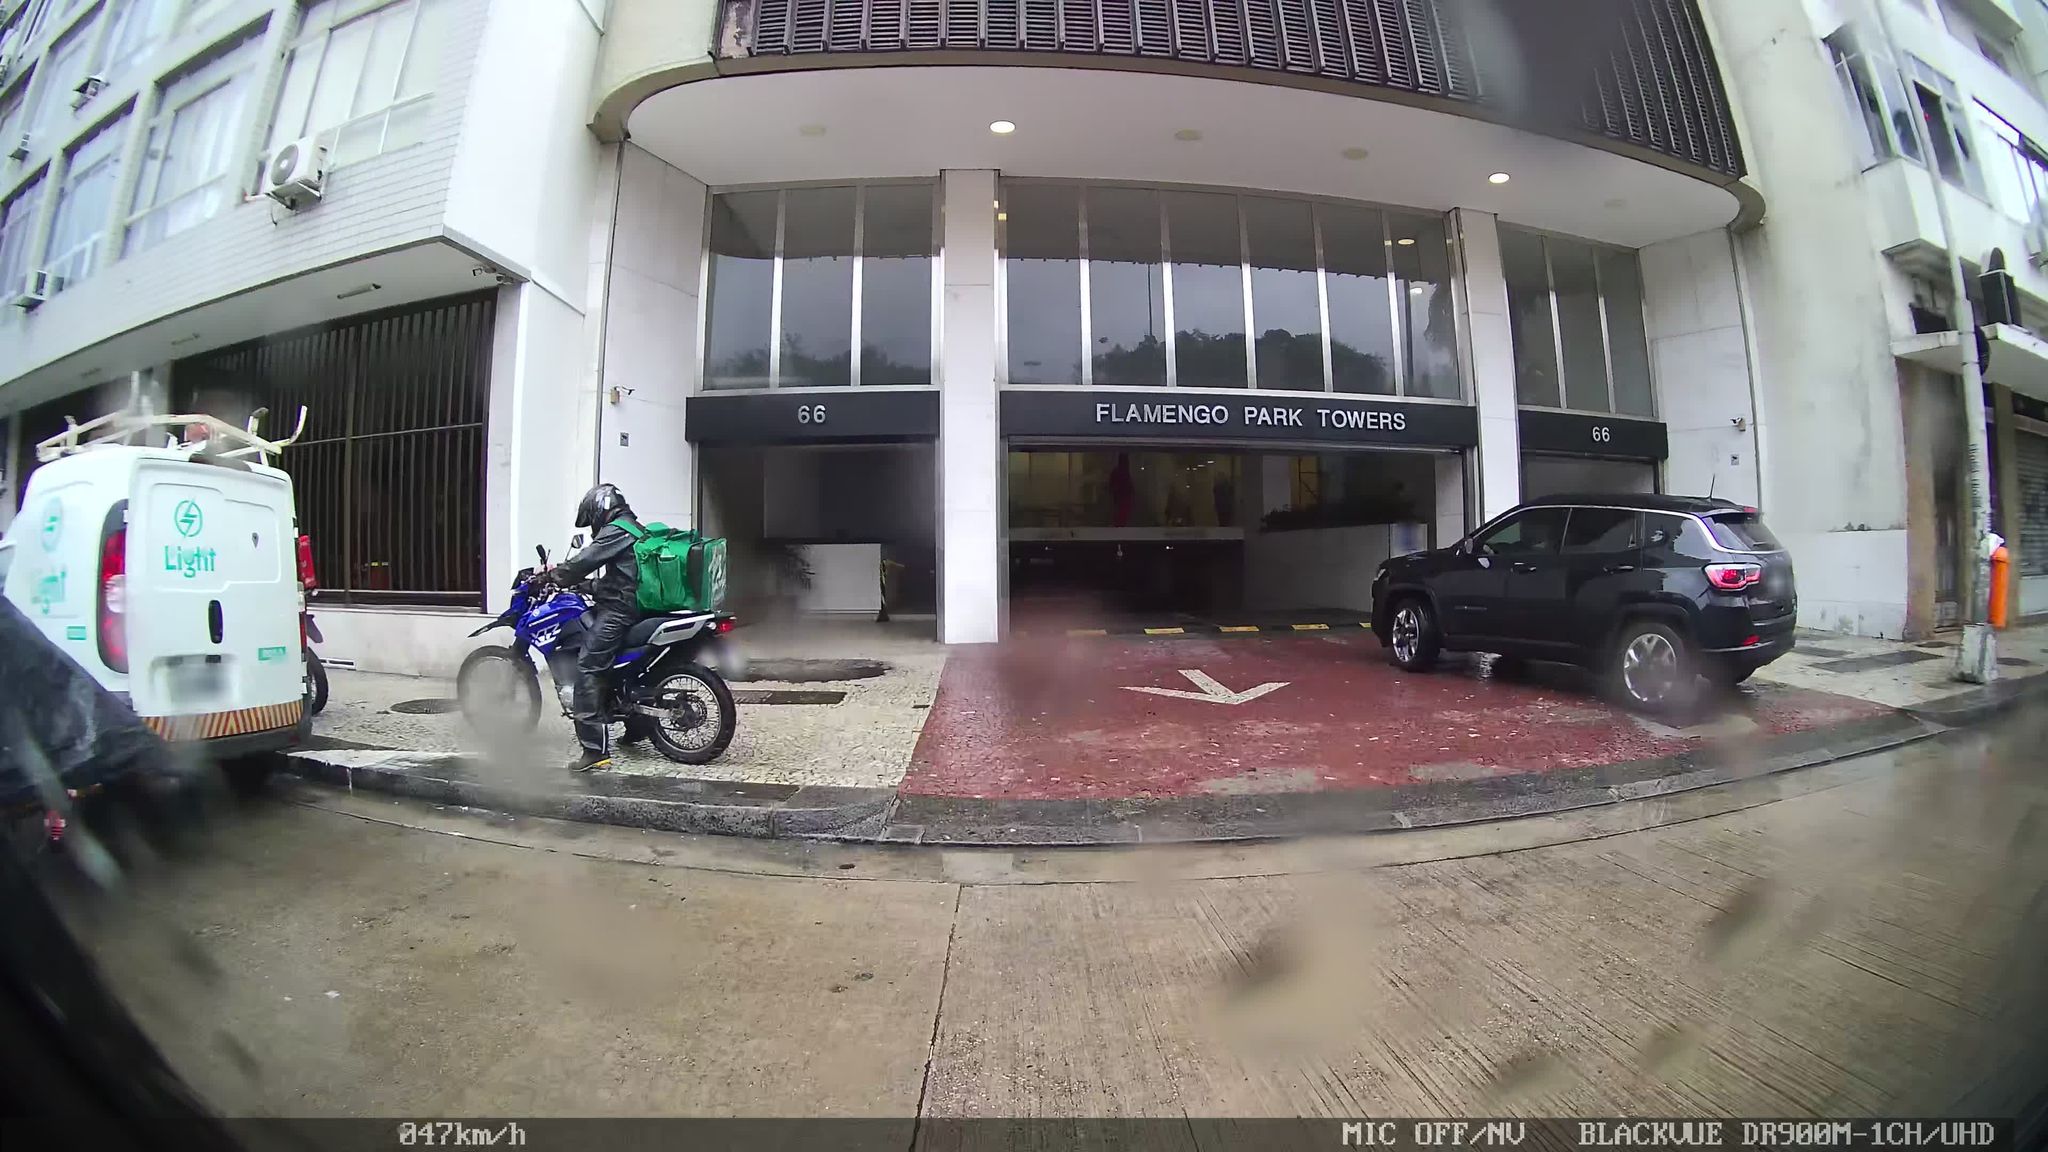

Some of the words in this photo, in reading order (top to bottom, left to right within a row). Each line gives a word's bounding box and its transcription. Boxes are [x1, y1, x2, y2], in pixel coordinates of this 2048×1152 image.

[798, 405, 825, 423] 66
[1095, 403, 1229, 425] FLAMENGO
[1244, 406, 1303, 427] PARK
[1317, 409, 1406, 430] TOWERS
[1592, 426, 1610, 442] 66
[164, 546, 216, 577] Light
